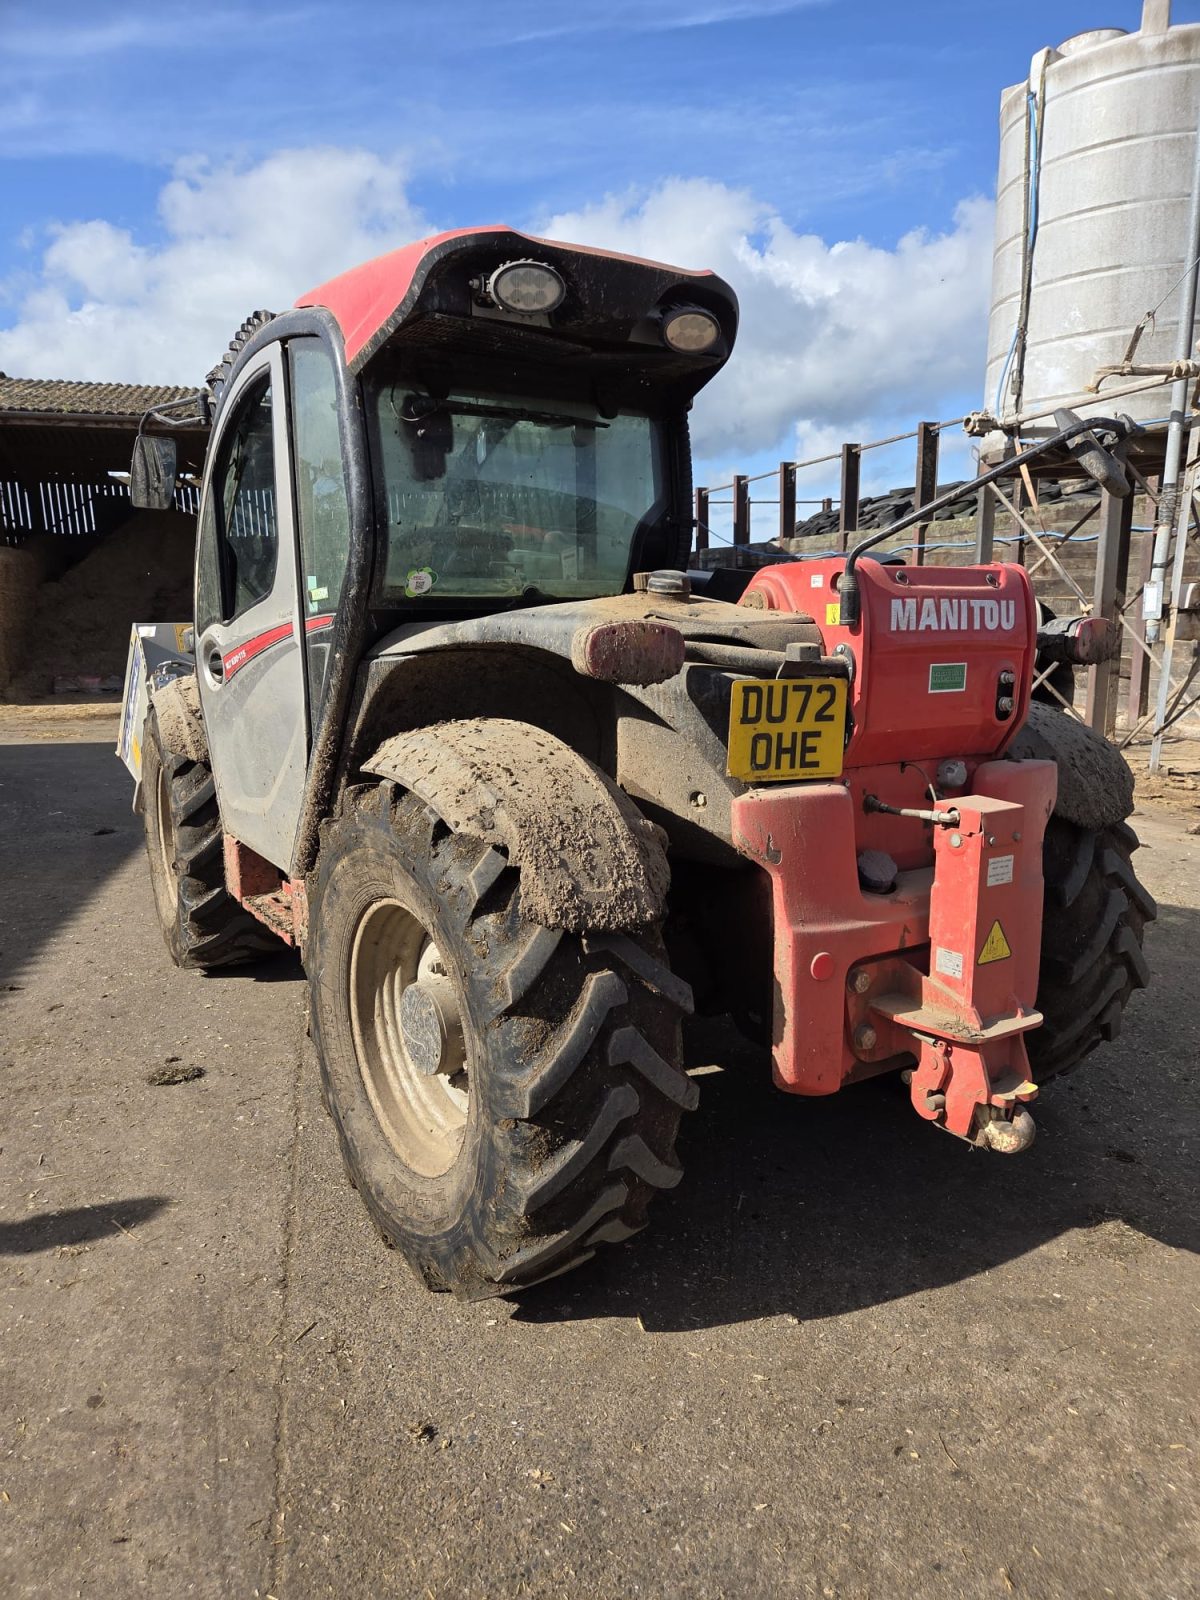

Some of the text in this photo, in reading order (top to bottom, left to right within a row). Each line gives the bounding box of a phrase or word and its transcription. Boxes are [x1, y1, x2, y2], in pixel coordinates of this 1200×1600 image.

[890, 598, 1015, 631] MANITOU
[740, 684, 836, 724] DU72
[750, 731, 822, 770] OHE
